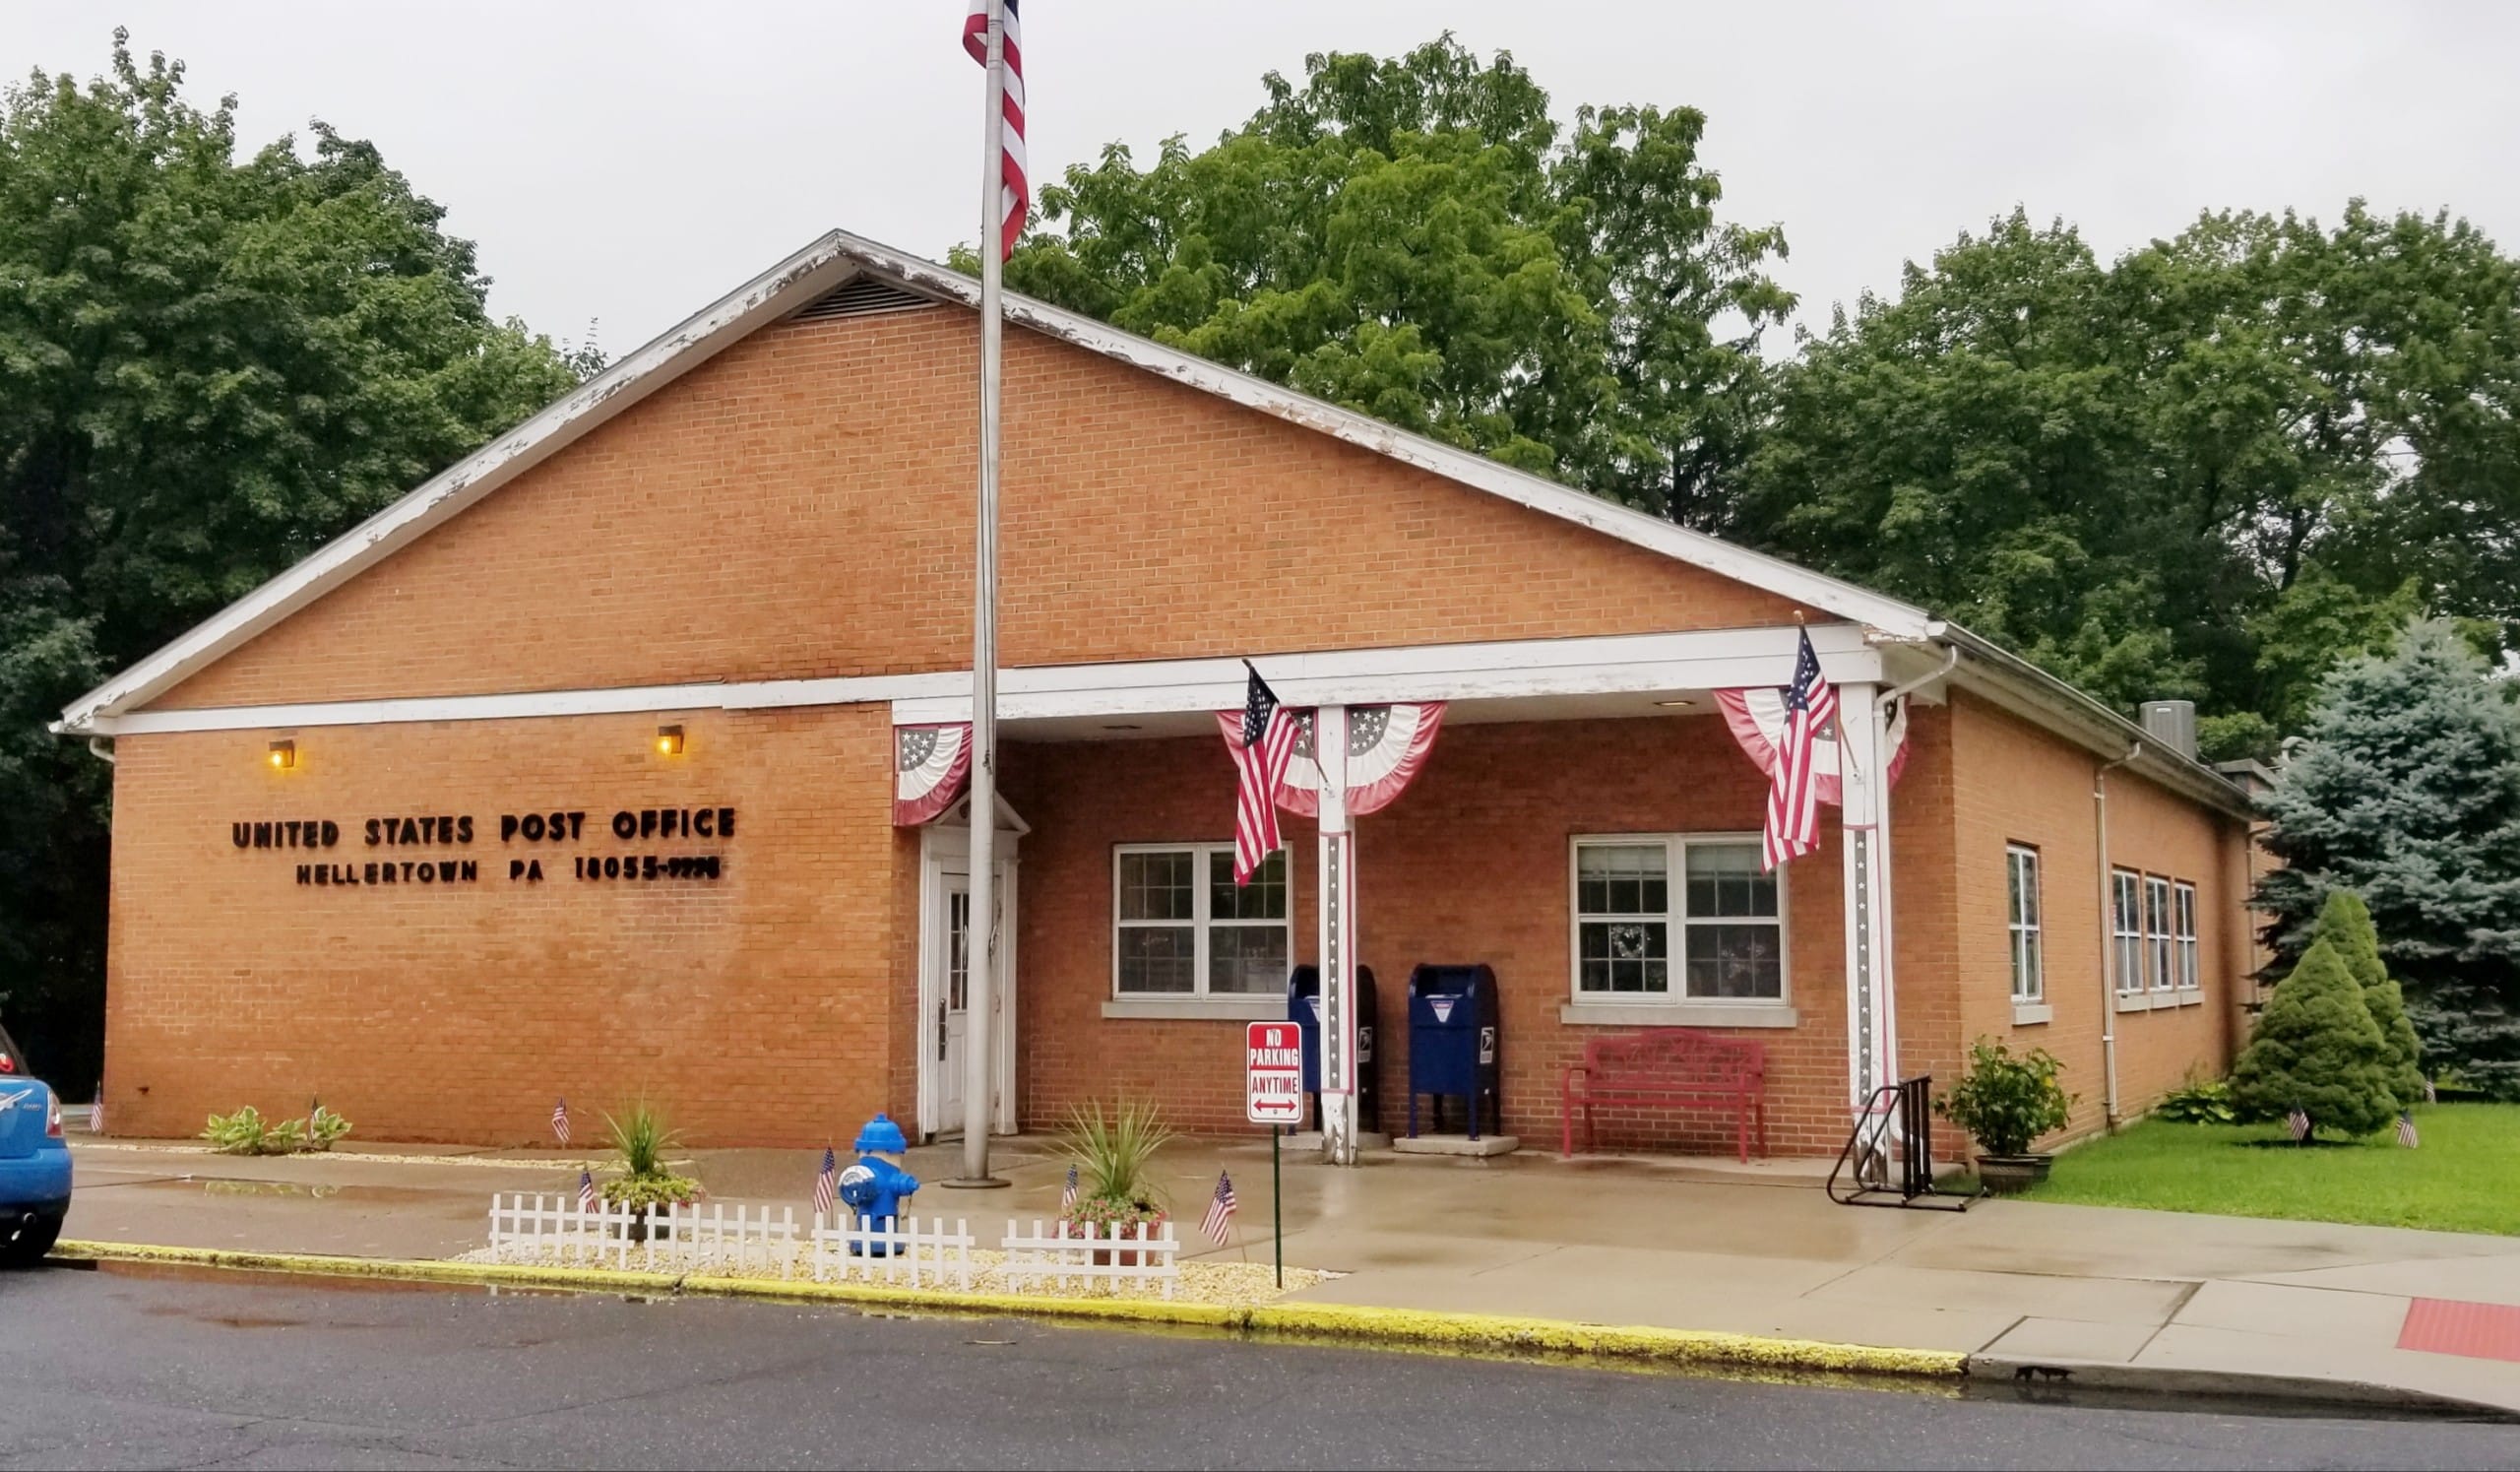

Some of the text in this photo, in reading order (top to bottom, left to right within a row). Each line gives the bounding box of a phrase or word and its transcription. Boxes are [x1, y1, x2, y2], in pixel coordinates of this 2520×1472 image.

[232, 808, 736, 849] UNITED STATES POST OFFICE
[296, 860, 478, 885] HELLERTOWN
[510, 859, 543, 881] PA
[1266, 1029, 1283, 1047] NO
[1250, 1048, 1298, 1066] PARKING
[1252, 1077, 1298, 1095] ANYTIME
